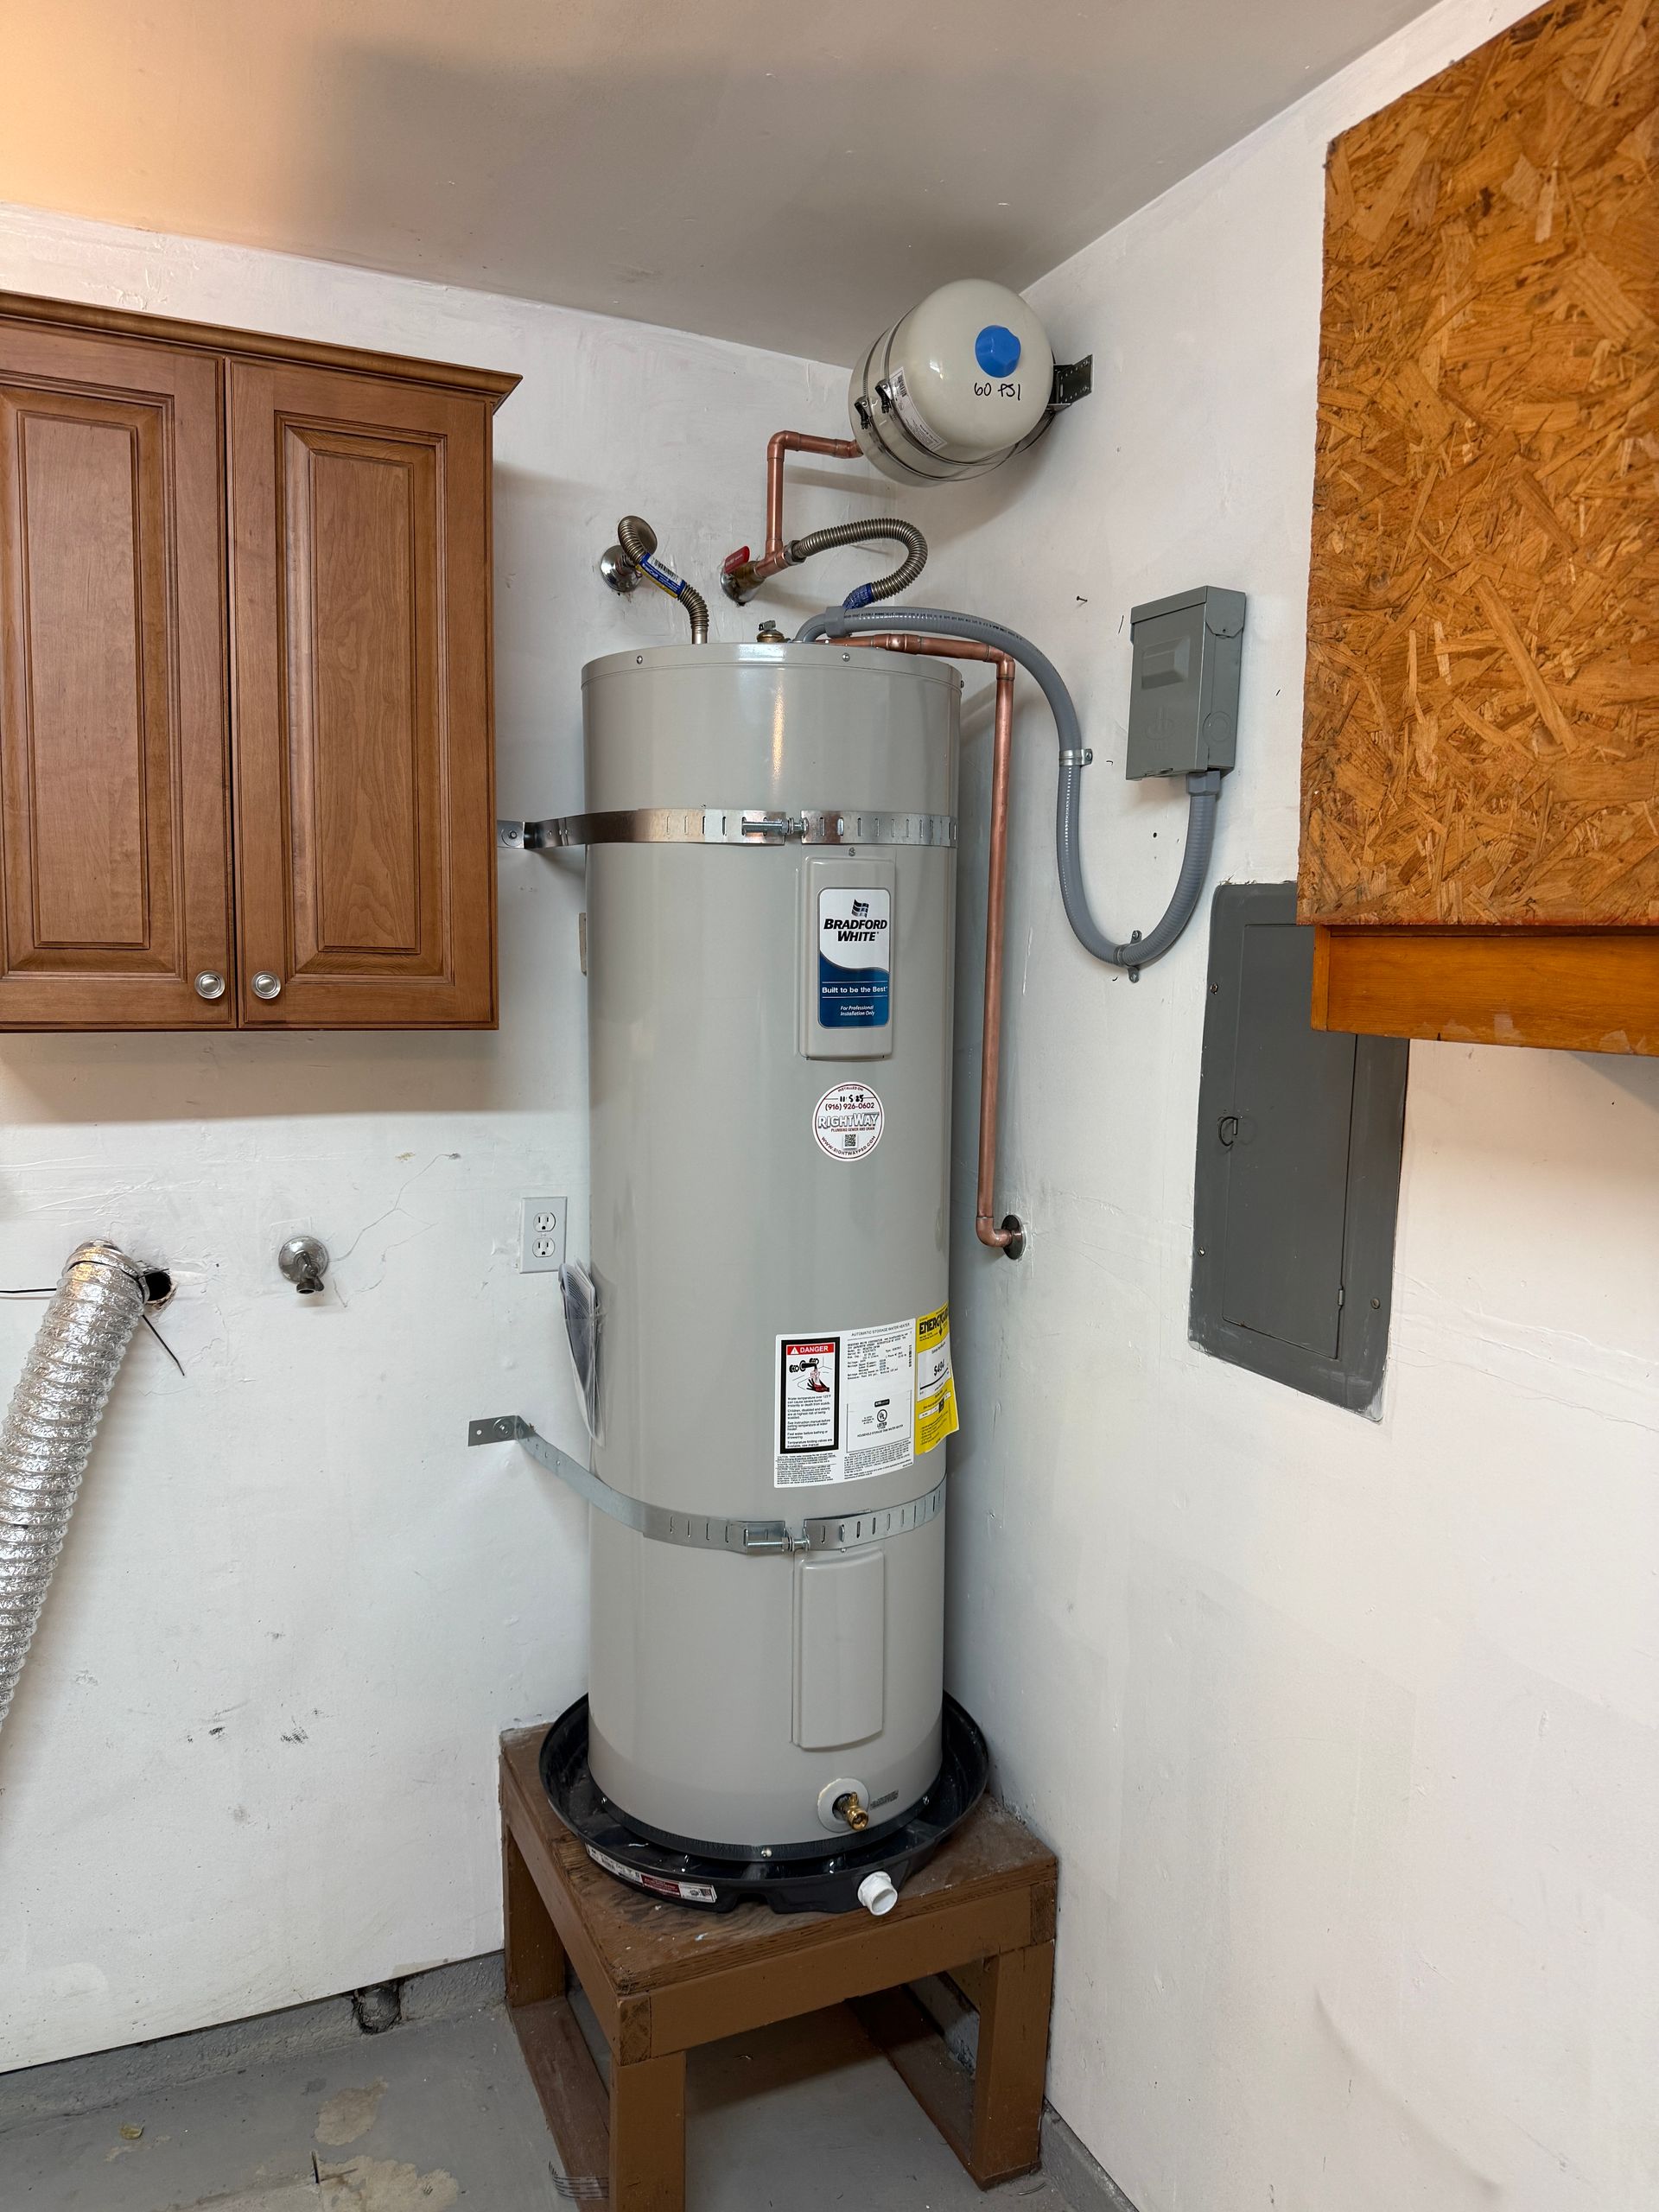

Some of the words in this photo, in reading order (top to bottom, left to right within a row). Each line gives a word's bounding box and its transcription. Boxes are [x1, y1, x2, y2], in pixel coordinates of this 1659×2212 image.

[974, 382, 992, 396] 60
[997, 383, 1020, 401] PSI
[823, 918, 887, 930] BRADFORD
[837, 931, 876, 942] WHITE
